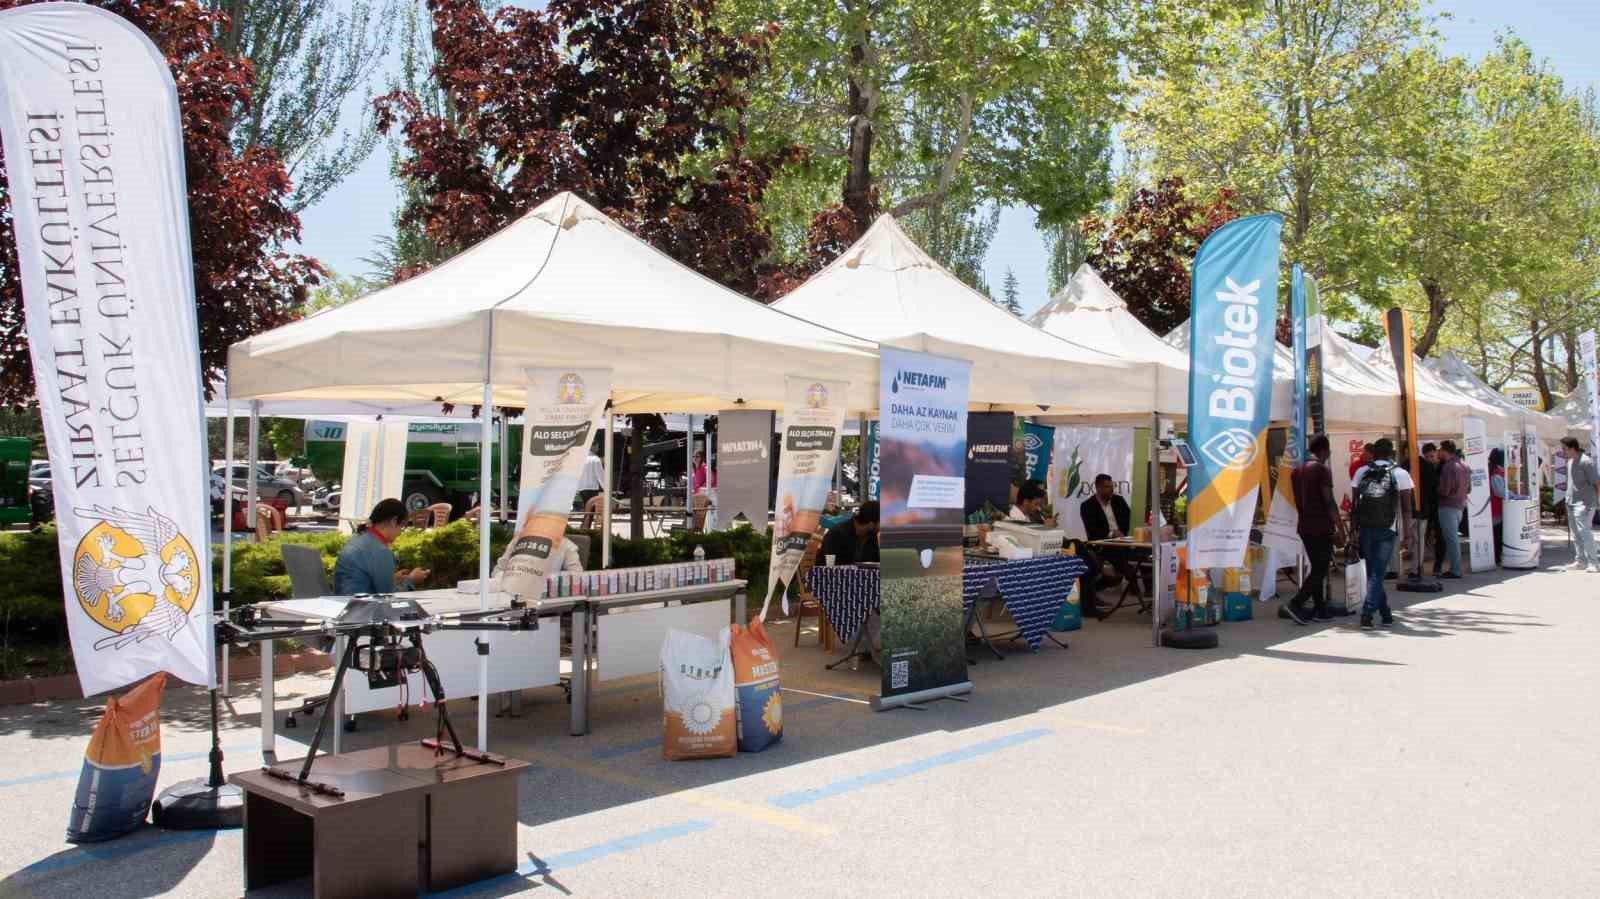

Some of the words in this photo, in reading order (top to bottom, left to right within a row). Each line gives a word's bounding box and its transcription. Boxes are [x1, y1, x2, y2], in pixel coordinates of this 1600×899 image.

[1209, 276, 1260, 421] Biotek
[903, 371, 947, 389] NETAFIM
[891, 403, 914, 416] DAHA
[916, 406, 927, 417] AZ
[928, 407, 958, 420] KAYNAK
[976, 444, 1008, 453] NETAFIM
